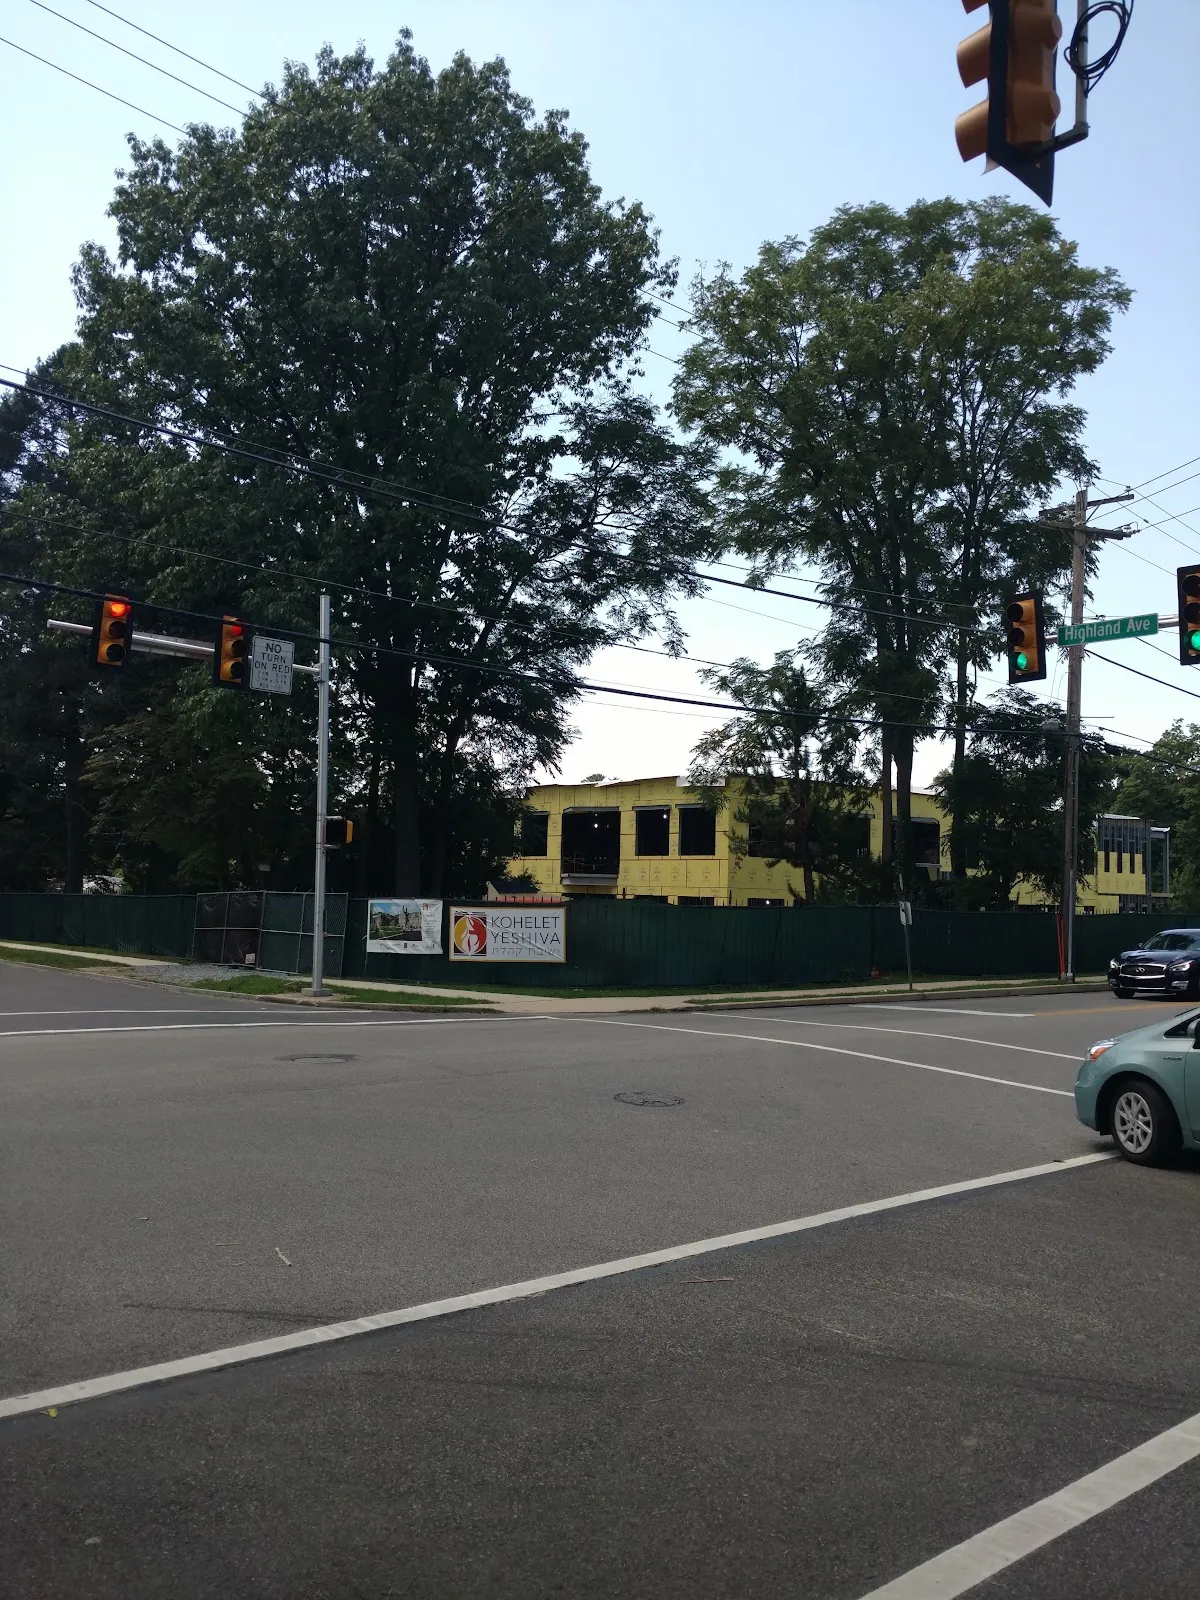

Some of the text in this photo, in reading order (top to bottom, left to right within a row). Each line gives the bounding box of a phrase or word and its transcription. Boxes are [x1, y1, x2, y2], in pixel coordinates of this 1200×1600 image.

[1065, 618, 1150, 643] Highland Ave
[265, 643, 282, 654] NO
[261, 653, 286, 664] TURN
[255, 661, 290, 674] ON RED
[491, 916, 560, 929] KOHELET
[490, 931, 561, 945] YESHIVA
